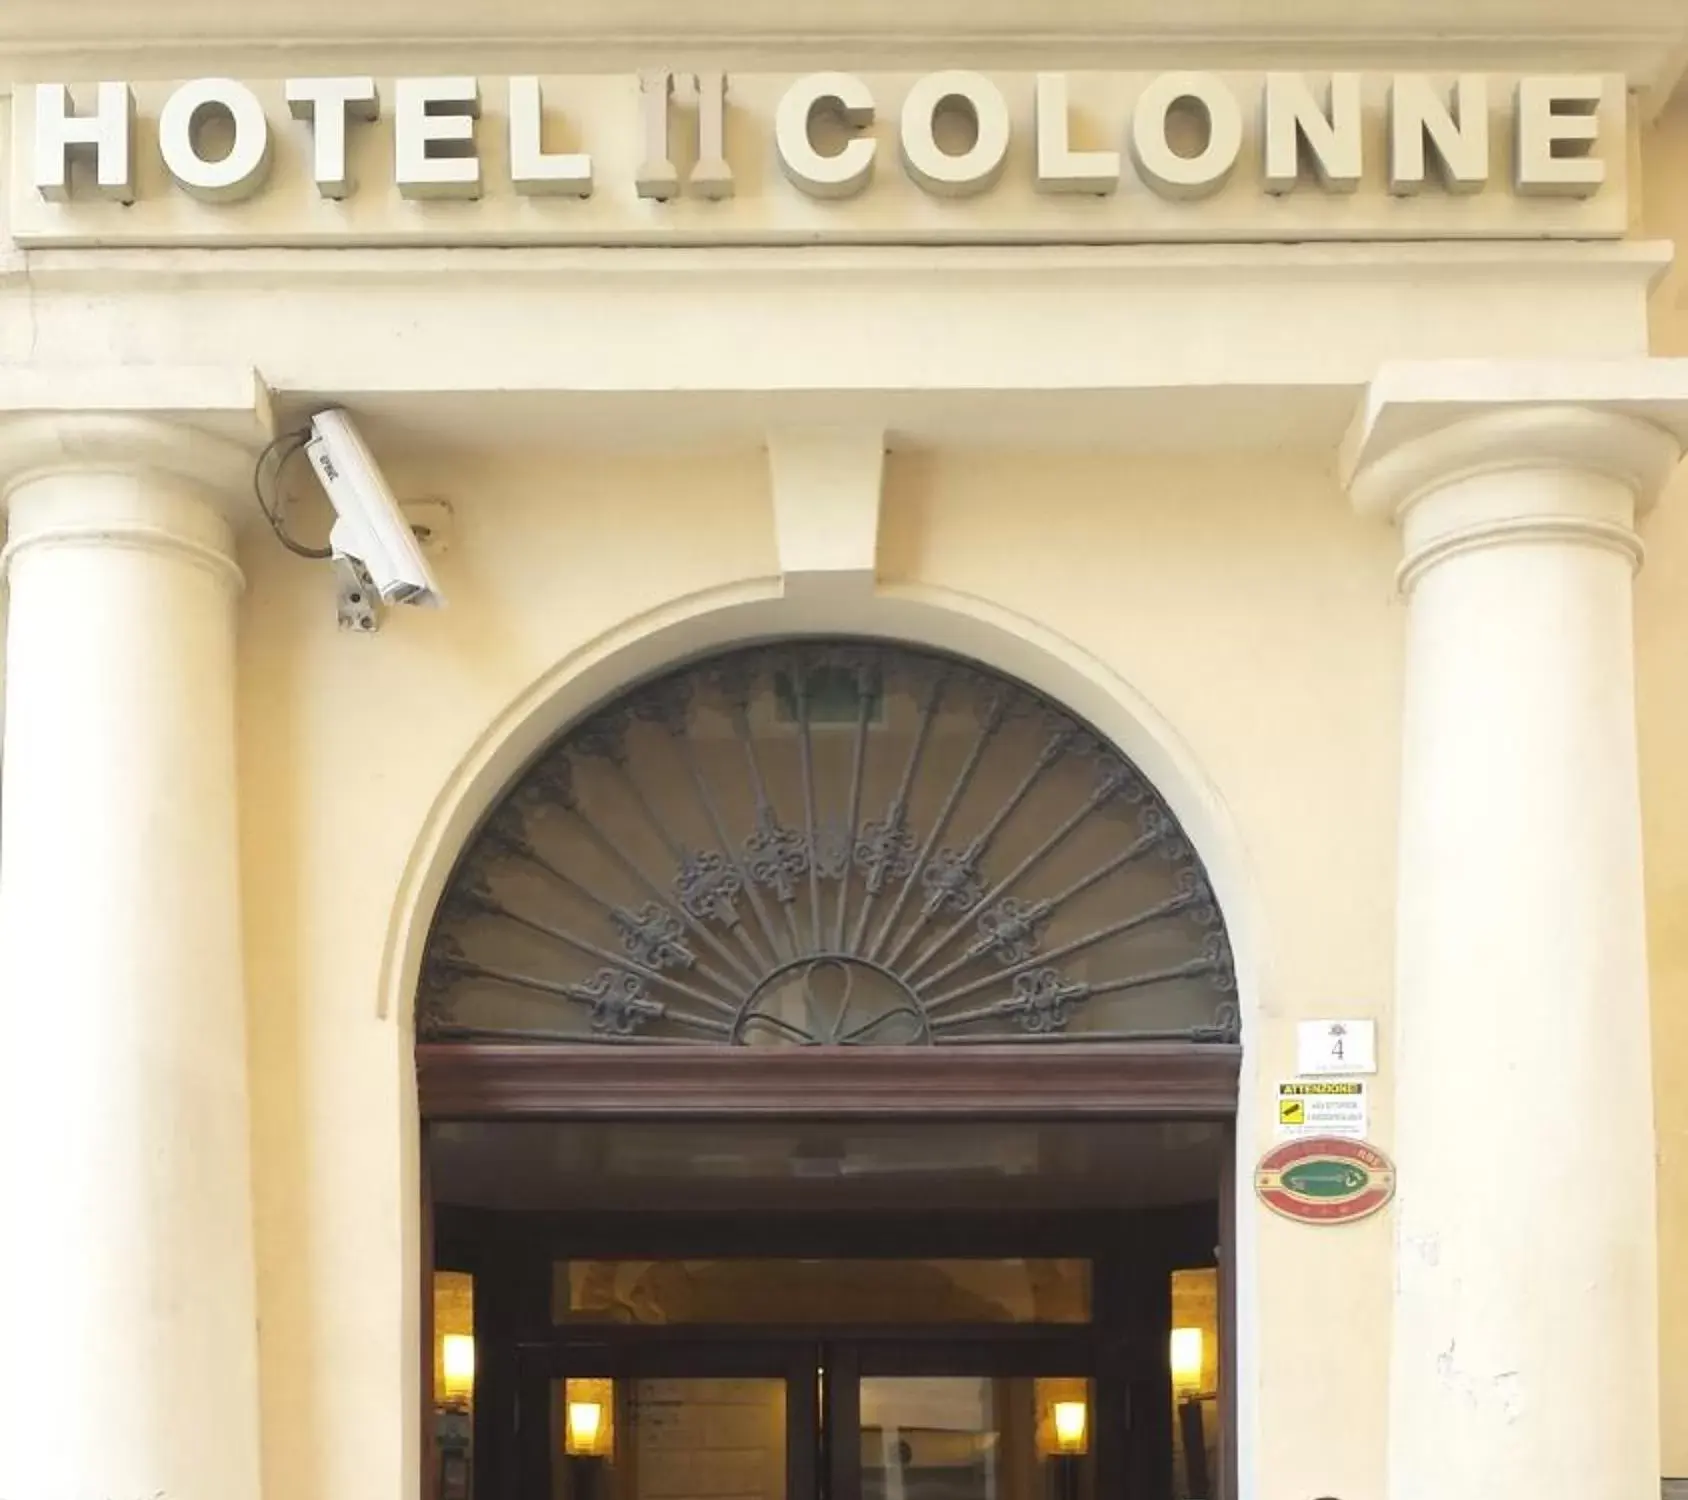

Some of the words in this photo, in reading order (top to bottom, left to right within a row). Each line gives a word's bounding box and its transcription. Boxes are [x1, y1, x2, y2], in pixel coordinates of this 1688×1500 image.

[35, 76, 592, 198] HOTEL
[775, 70, 1606, 198] COLONNE
[1331, 1038, 1344, 1060] 4
